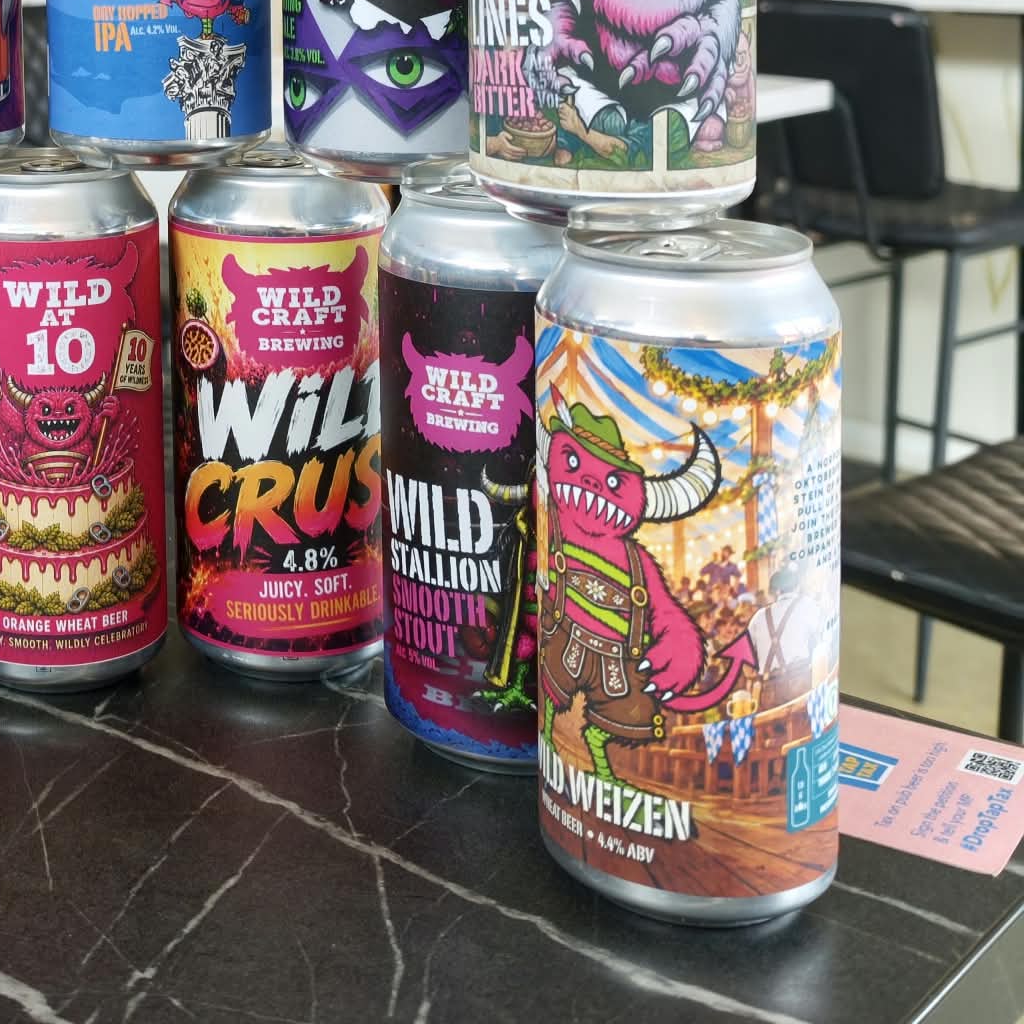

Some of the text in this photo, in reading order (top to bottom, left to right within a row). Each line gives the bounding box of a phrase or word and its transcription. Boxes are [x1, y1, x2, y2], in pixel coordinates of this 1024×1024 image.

[117, 4, 168, 21] HOPPED
[95, 22, 133, 53] IPA
[146, 25, 165, 36] 4.2%
[472, 85, 535, 117] BITTER
[3, 278, 112, 308] WILD
[257, 285, 342, 308] WILD
[40, 308, 75, 326] AT
[252, 305, 346, 326] CRAFT
[26, 328, 96, 375] 10
[127, 337, 147, 362] 10
[258, 336, 344, 352] BREWING
[126, 364, 146, 375] YEARS
[426, 365, 498, 393] WILD
[421, 384, 504, 411] CRAFT
[426, 412, 499, 434] BREWING
[386, 468, 494, 554] WILD
[792, 518, 816, 533] JOIN
[283, 545, 338, 572] 4.8%
[391, 537, 502, 593] STALLION
[259, 572, 353, 599] JUICY. SOFT.
[226, 599, 304, 622] SERIOUSLY
[392, 572, 488, 628] SMOOTH
[2, 609, 128, 633] ORANGE WHEAT BEER
[393, 606, 458, 658] STOUT
[55, 637, 91, 650] WILDLY
[568, 763, 690, 841] WEIZEN
[960, 786, 1014, 853] #DropTapTax
[561, 808, 583, 838] BEER
[597, 831, 625, 856] 4.4%
[626, 842, 656, 863] ABV
